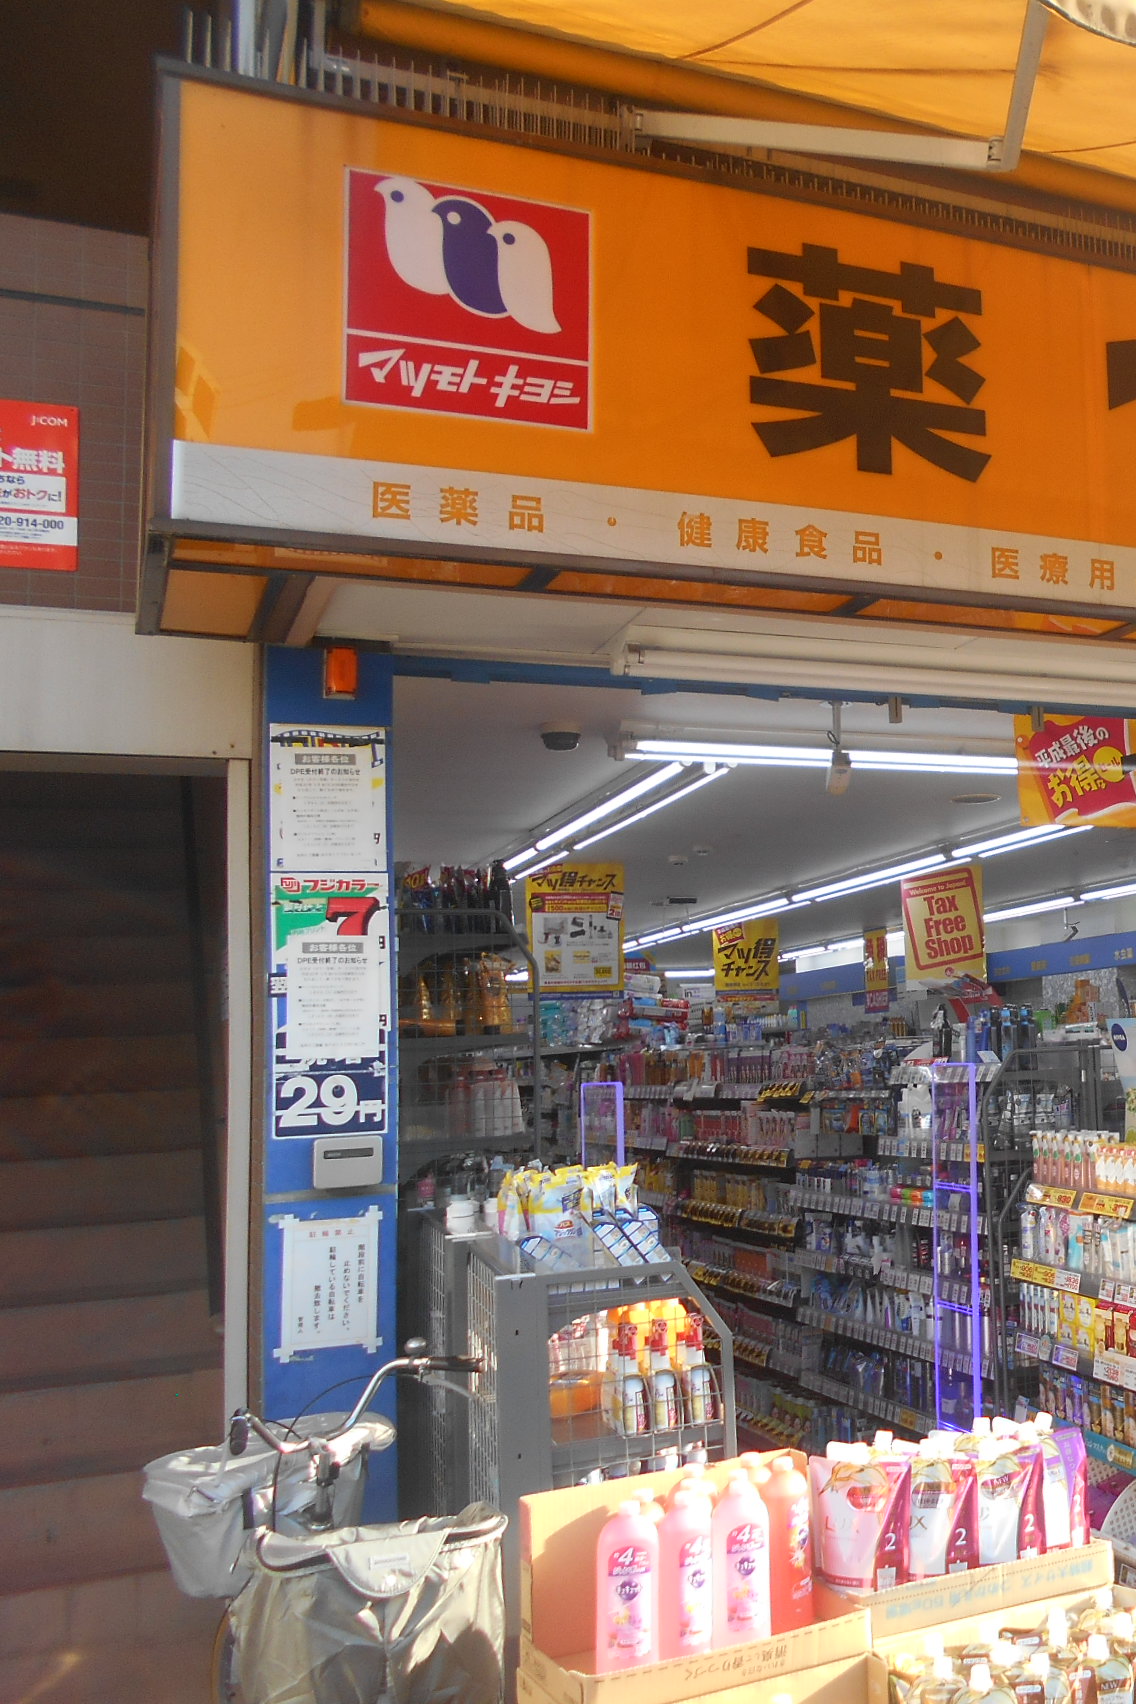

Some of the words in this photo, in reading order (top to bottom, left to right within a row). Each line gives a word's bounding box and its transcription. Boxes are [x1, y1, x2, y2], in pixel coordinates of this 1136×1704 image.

[746, 242, 992, 483] 薬
[357, 348, 581, 408] マツモトキヨシ
[372, 480, 545, 533] 医薬品
[676, 510, 884, 566] 健康食品
[1035, 725, 1109, 768] 平成最後の
[303, 879, 383, 892] フジカラー
[531, 871, 617, 891] マツ得チャンス
[909, 886, 938, 896] Welcome
[923, 894, 959, 917] Tax
[923, 914, 967, 938] Free
[717, 938, 777, 964] マツ得
[925, 934, 975, 960] Shop
[721, 960, 771, 981] チャンス
[278, 1074, 383, 1128] 29円
[1023, 1513, 1035, 1532] 2
[884, 1532, 897, 1551] 2
[955, 1527, 967, 1546] 2
